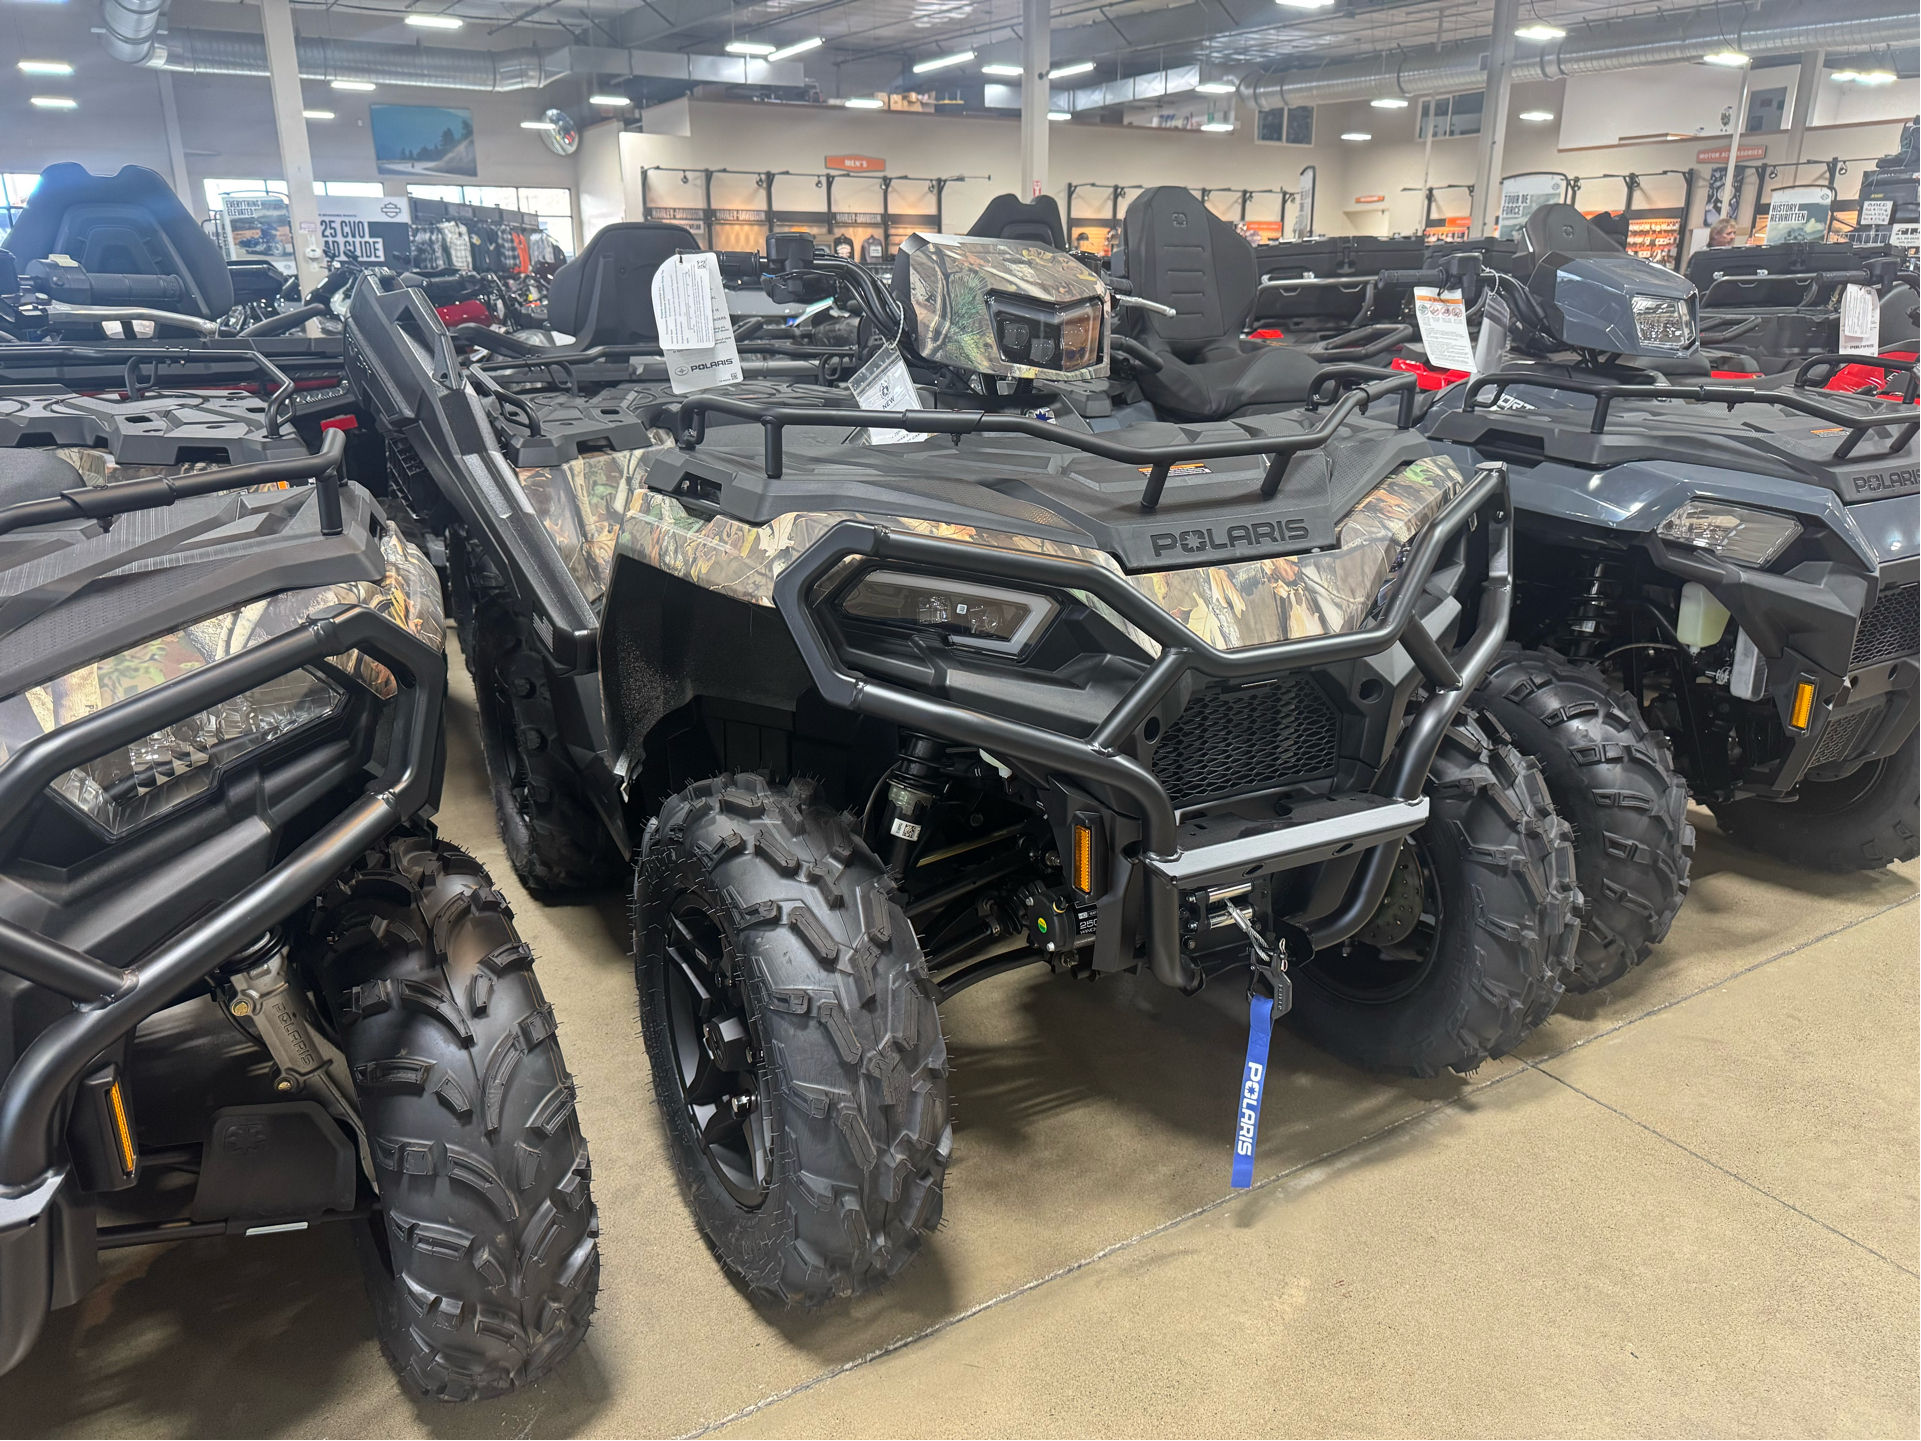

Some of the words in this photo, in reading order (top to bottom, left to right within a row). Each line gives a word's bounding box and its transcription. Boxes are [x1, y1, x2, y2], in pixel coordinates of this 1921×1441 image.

[1721, 149, 1762, 158] ACSSORIES
[844, 158, 868, 168] MEN'S
[225, 200, 260, 209] EVERYTHING
[1504, 194, 1520, 205] TOUR
[1521, 194, 1529, 205] DE
[228, 209, 254, 217] ELEVATED
[652, 208, 704, 219] HARLEY-DAVIDSON
[1502, 205, 1521, 216] FORCE
[1771, 203, 1798, 213] HISTORY
[715, 209, 766, 221] HARLEY-DAVIDSON
[836, 212, 882, 223] HARLEY-DAVIDSON
[1770, 212, 1806, 223] REWRITTEN
[340, 220, 366, 239] CVO
[690, 358, 734, 373] POLARIS
[882, 396, 895, 409] NEW
[1150, 518, 1310, 558] POLARIS
[272, 1001, 315, 1066] POLARIS
[1237, 1061, 1263, 1156] POLARIS
